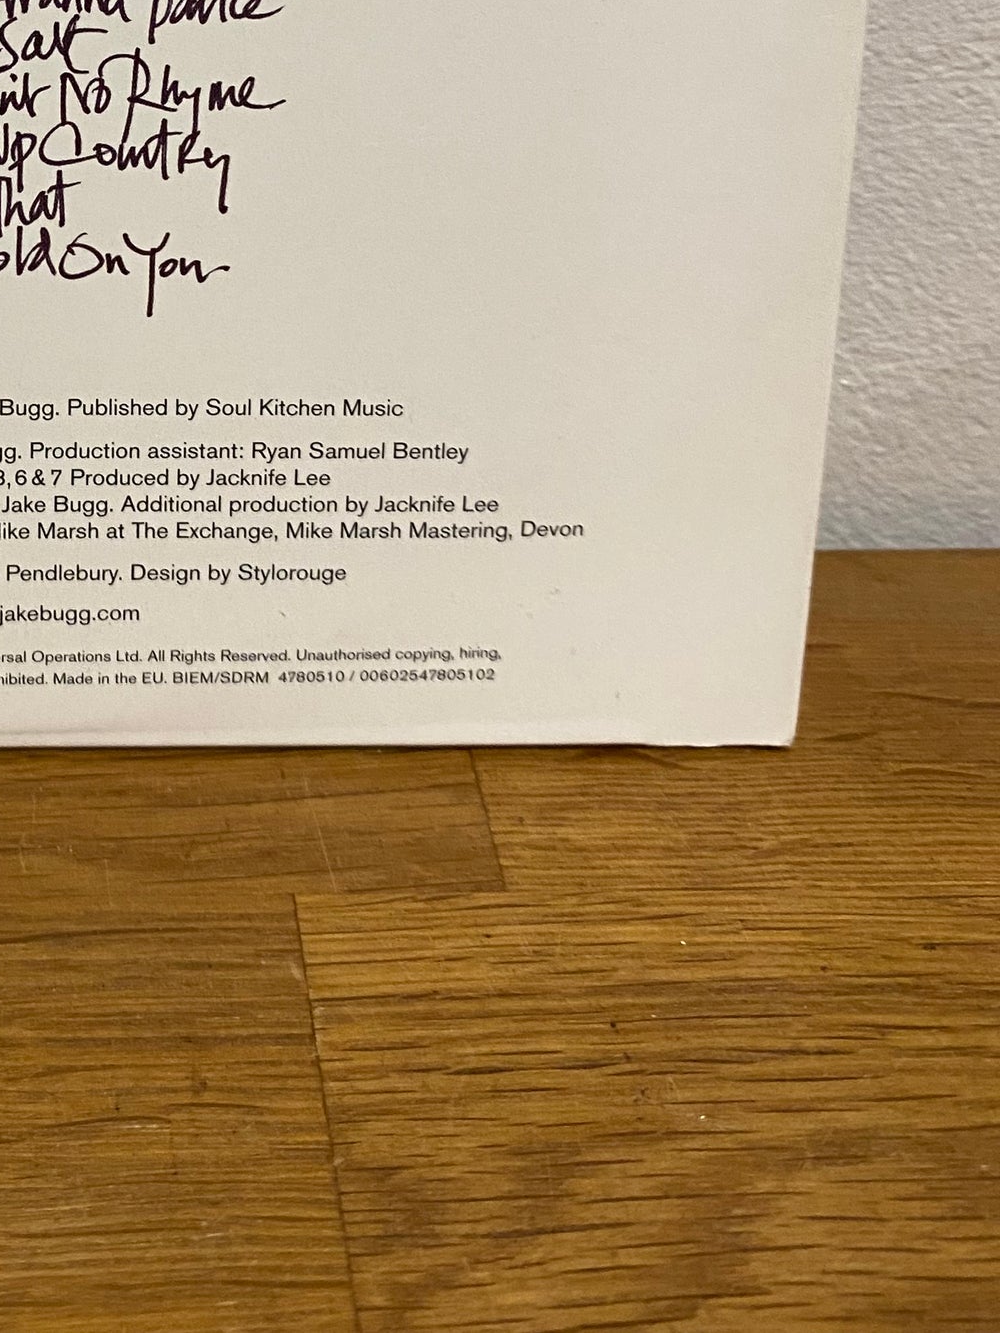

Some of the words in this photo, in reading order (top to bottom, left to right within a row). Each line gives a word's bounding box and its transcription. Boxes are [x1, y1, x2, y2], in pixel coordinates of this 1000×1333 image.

[60, 72, 111, 126] No
[98, 47, 287, 131] Rhyme
[58, 232, 130, 279] On
[122, 232, 231, 317] You
[0, 398, 60, 422] Bugg.
[67, 397, 168, 417] Published
[175, 398, 200, 422] by
[205, 397, 252, 417] Soul
[259, 398, 336, 417] Kitchen
[342, 398, 404, 417] Music
[29, 441, 141, 460] Production
[147, 441, 244, 460] assistant:
[251, 441, 302, 465] Ryan
[308, 441, 386, 460] Samuel
[392, 441, 470, 465] Bentley
[70, 467, 170, 487] Produced
[176, 467, 201, 492] by
[205, 468, 288, 487] Jacknife
[293, 468, 332, 487] Lee
[0, 494, 47, 514] Jake
[53, 494, 114, 518] Bugg.
[120, 494, 222, 513] Additional
[228, 494, 338, 518] production
[345, 494, 369, 518] by
[373, 494, 456, 513] Jacknife
[461, 494, 500, 514] Lee
[37, 521, 100, 540] Marsh
[105, 523, 126, 540] at
[130, 521, 169, 540] The
[175, 521, 279, 545] Exchange,
[285, 521, 334, 540] Mike
[339, 521, 402, 540] Marsh
[408, 521, 513, 543] Mastering,
[520, 519, 585, 538] Devon
[6, 563, 123, 587] Pendlebury.
[130, 563, 201, 586] Design
[207, 563, 232, 586] by
[237, 563, 347, 586] Stylorouge
[31, 649, 112, 667] Operations
[115, 649, 143, 663] Ltd.
[147, 649, 166, 663] All
[169, 648, 216, 666] Rights
[220, 648, 292, 663] Reserved.
[296, 647, 392, 662] Unauthorised
[394, 649, 455, 664] copying,
[459, 645, 502, 662] hiring,
[52, 671, 94, 686] Made
[97, 671, 110, 685] in
[114, 671, 138, 685] the
[141, 671, 168, 685] EU.
[172, 670, 270, 685] BIEM/SDRM
[277, 670, 346, 684] 4780510
[348, 670, 356, 682] /
[359, 667, 496, 683] 00602547805102
